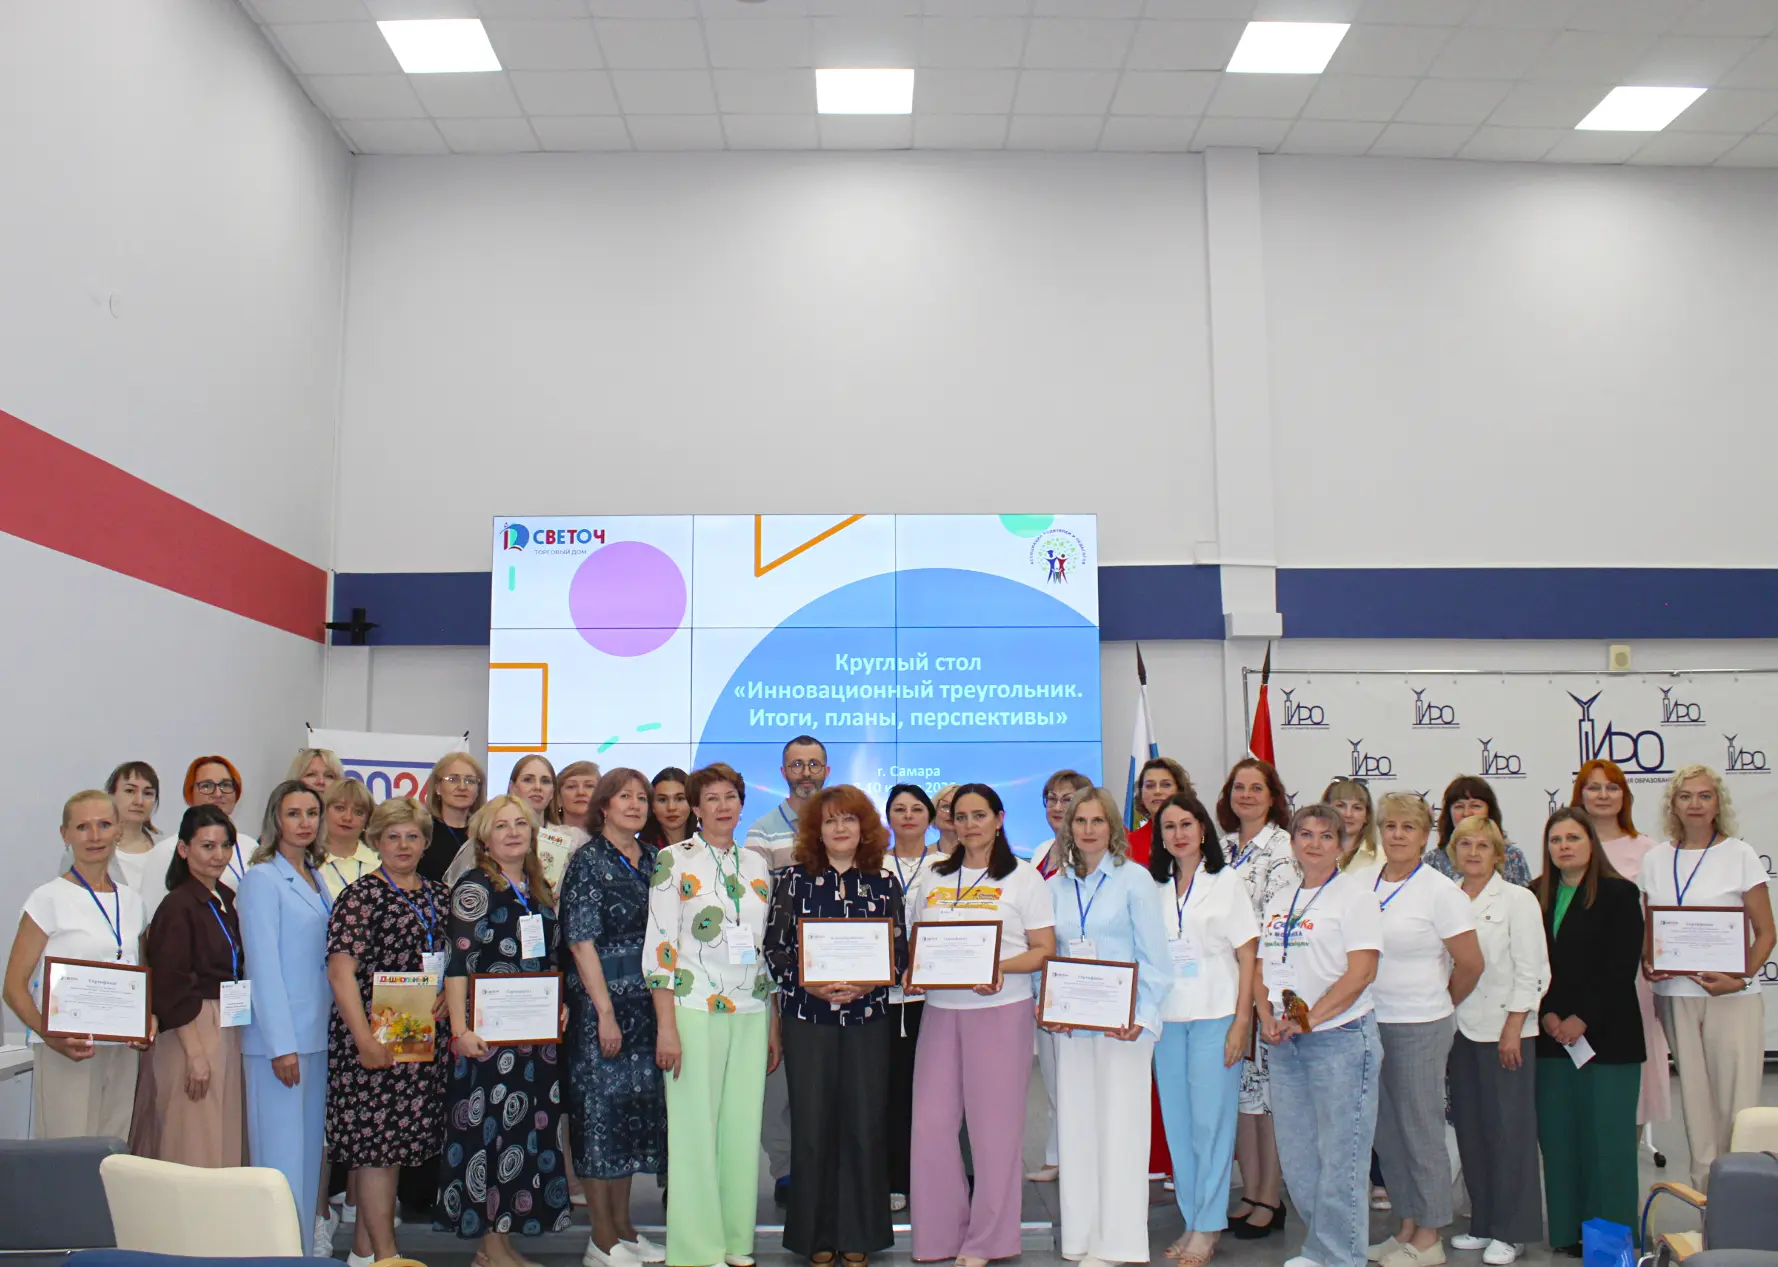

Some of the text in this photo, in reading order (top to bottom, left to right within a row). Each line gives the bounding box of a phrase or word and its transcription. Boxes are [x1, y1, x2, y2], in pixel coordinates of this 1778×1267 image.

[533, 529, 605, 544] СВЕТОЧ
[835, 652, 982, 675] Круглый стол
[734, 680, 1083, 702] «Инновационный треугольник.
[749, 708, 1068, 730] Итоги, планы, перспективы»
[877, 765, 941, 778] г. Самара
